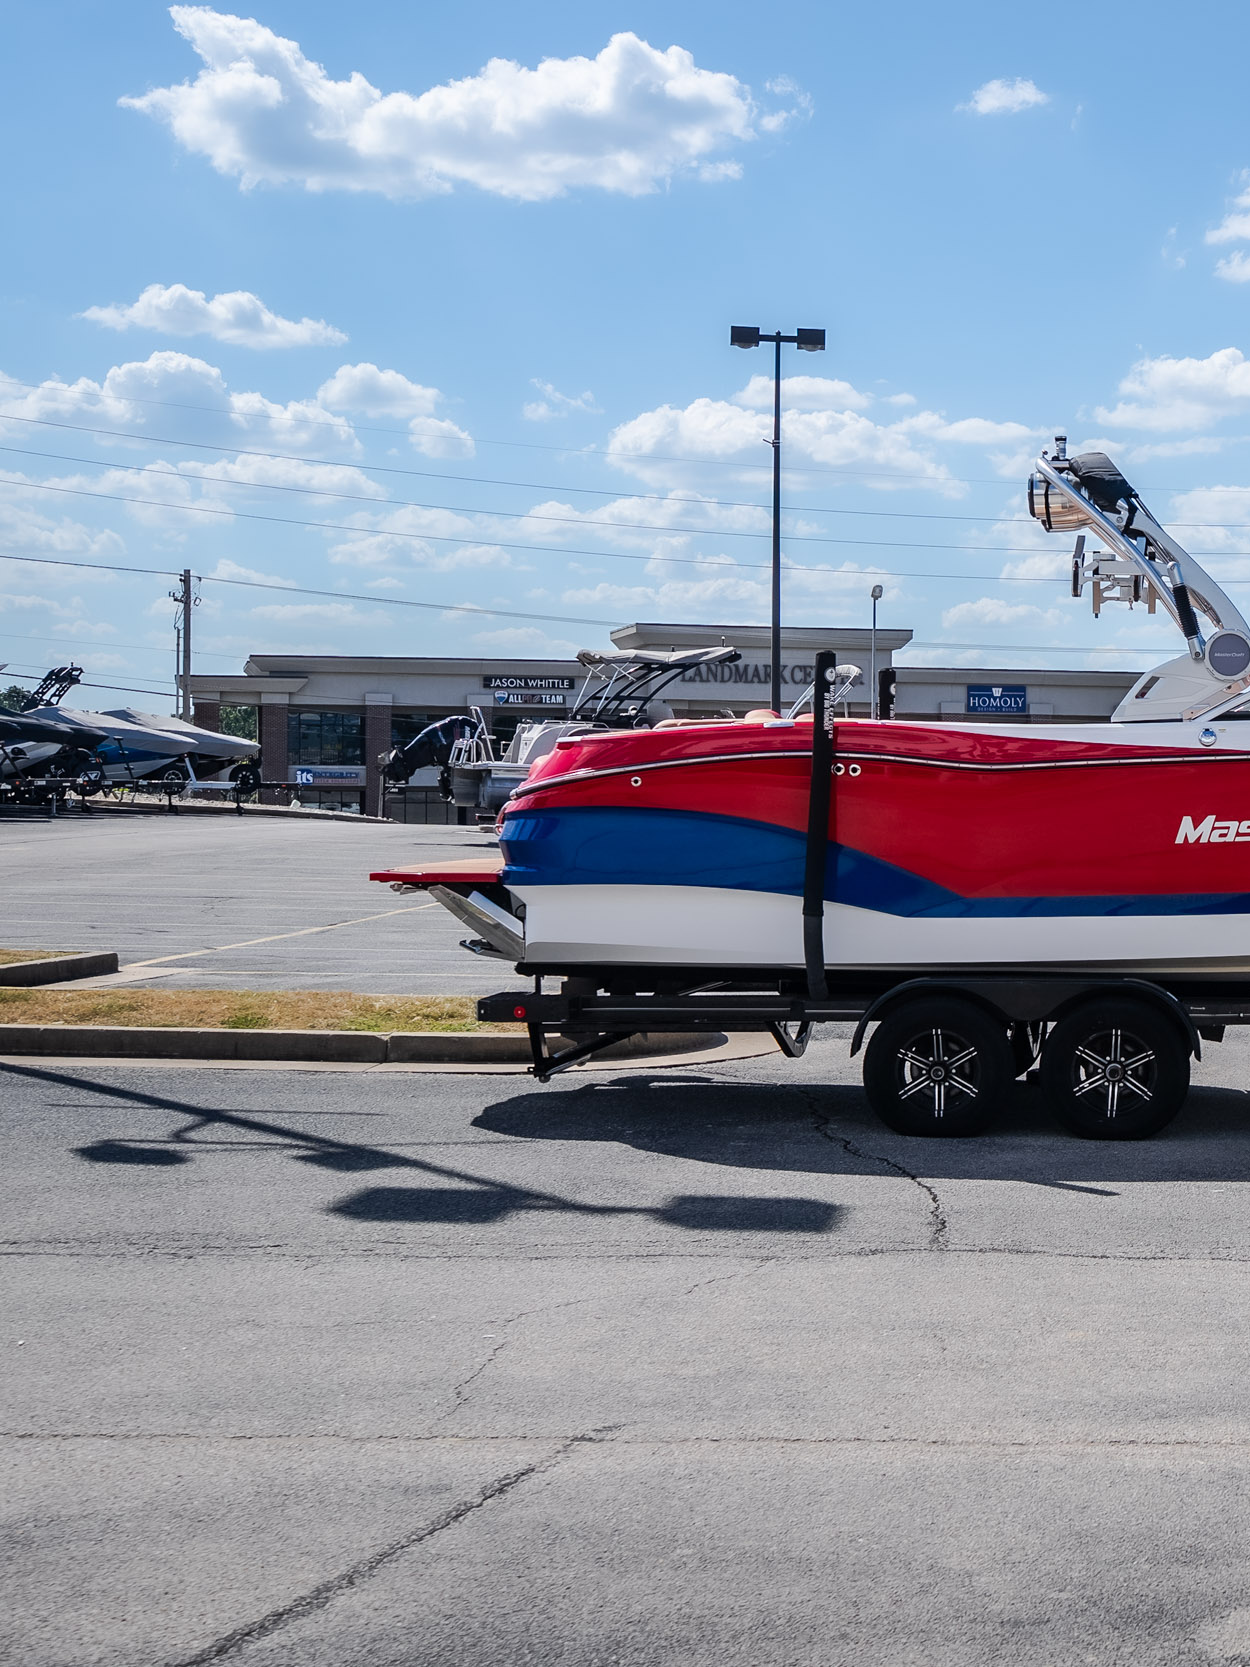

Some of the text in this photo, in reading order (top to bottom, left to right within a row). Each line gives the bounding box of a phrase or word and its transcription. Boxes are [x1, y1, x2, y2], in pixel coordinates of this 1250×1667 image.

[680, 664, 789, 684] LANDMARK
[490, 678, 570, 688] JASON WHITTLE
[541, 695, 563, 704] TEAM
[970, 696, 1025, 707] HOMOLY
[295, 770, 314, 783] its
